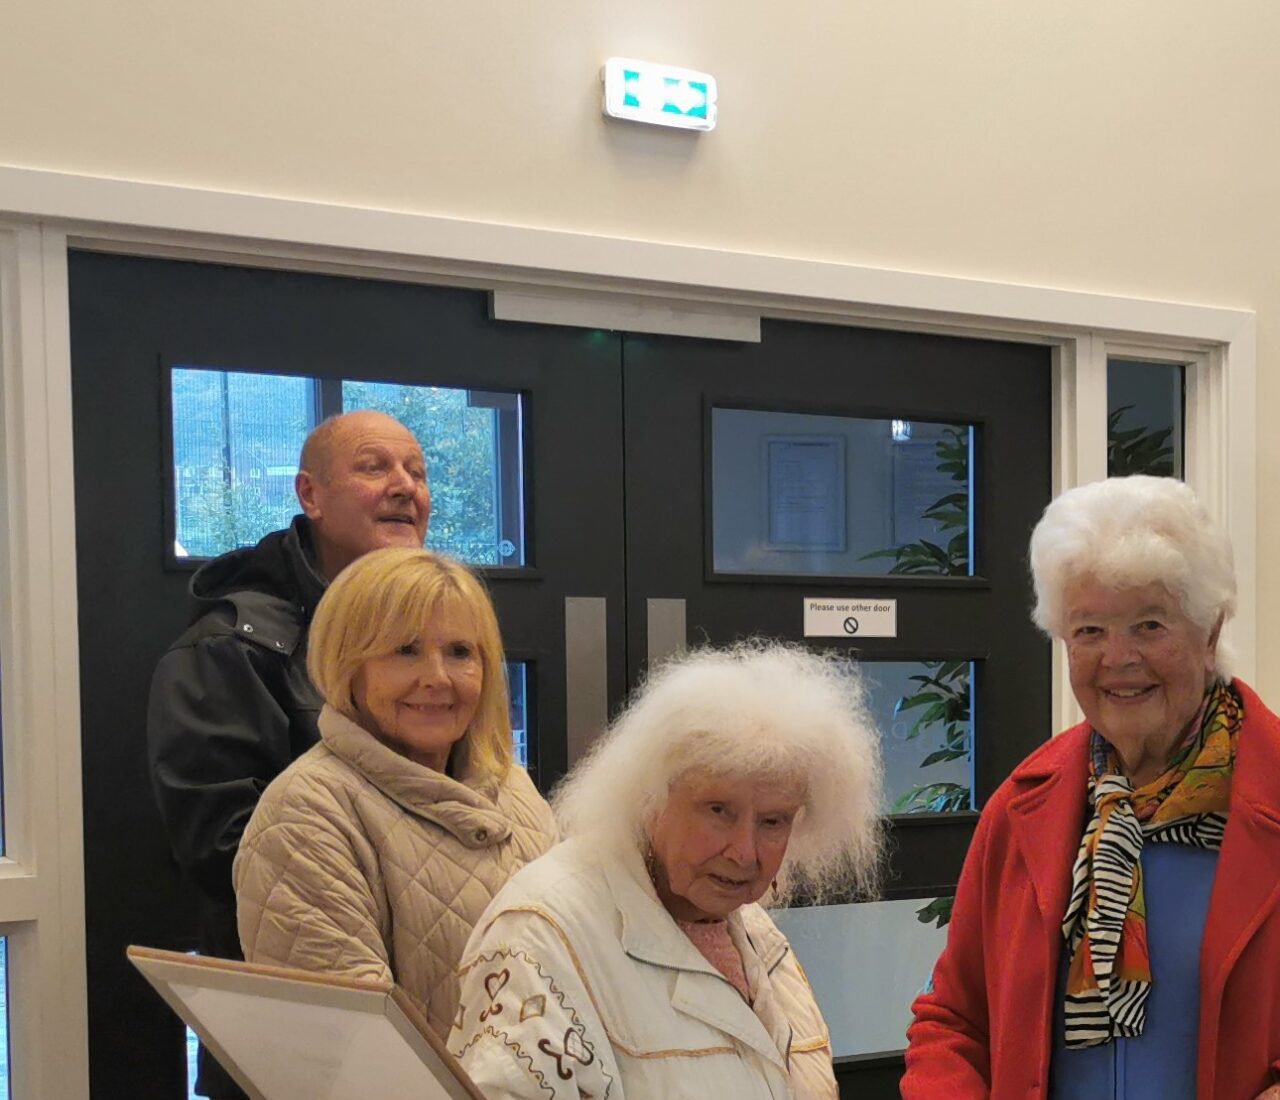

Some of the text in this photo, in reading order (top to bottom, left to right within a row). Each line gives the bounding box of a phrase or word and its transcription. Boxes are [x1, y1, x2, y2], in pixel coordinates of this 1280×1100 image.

[810, 603, 890, 612] Please use other door
